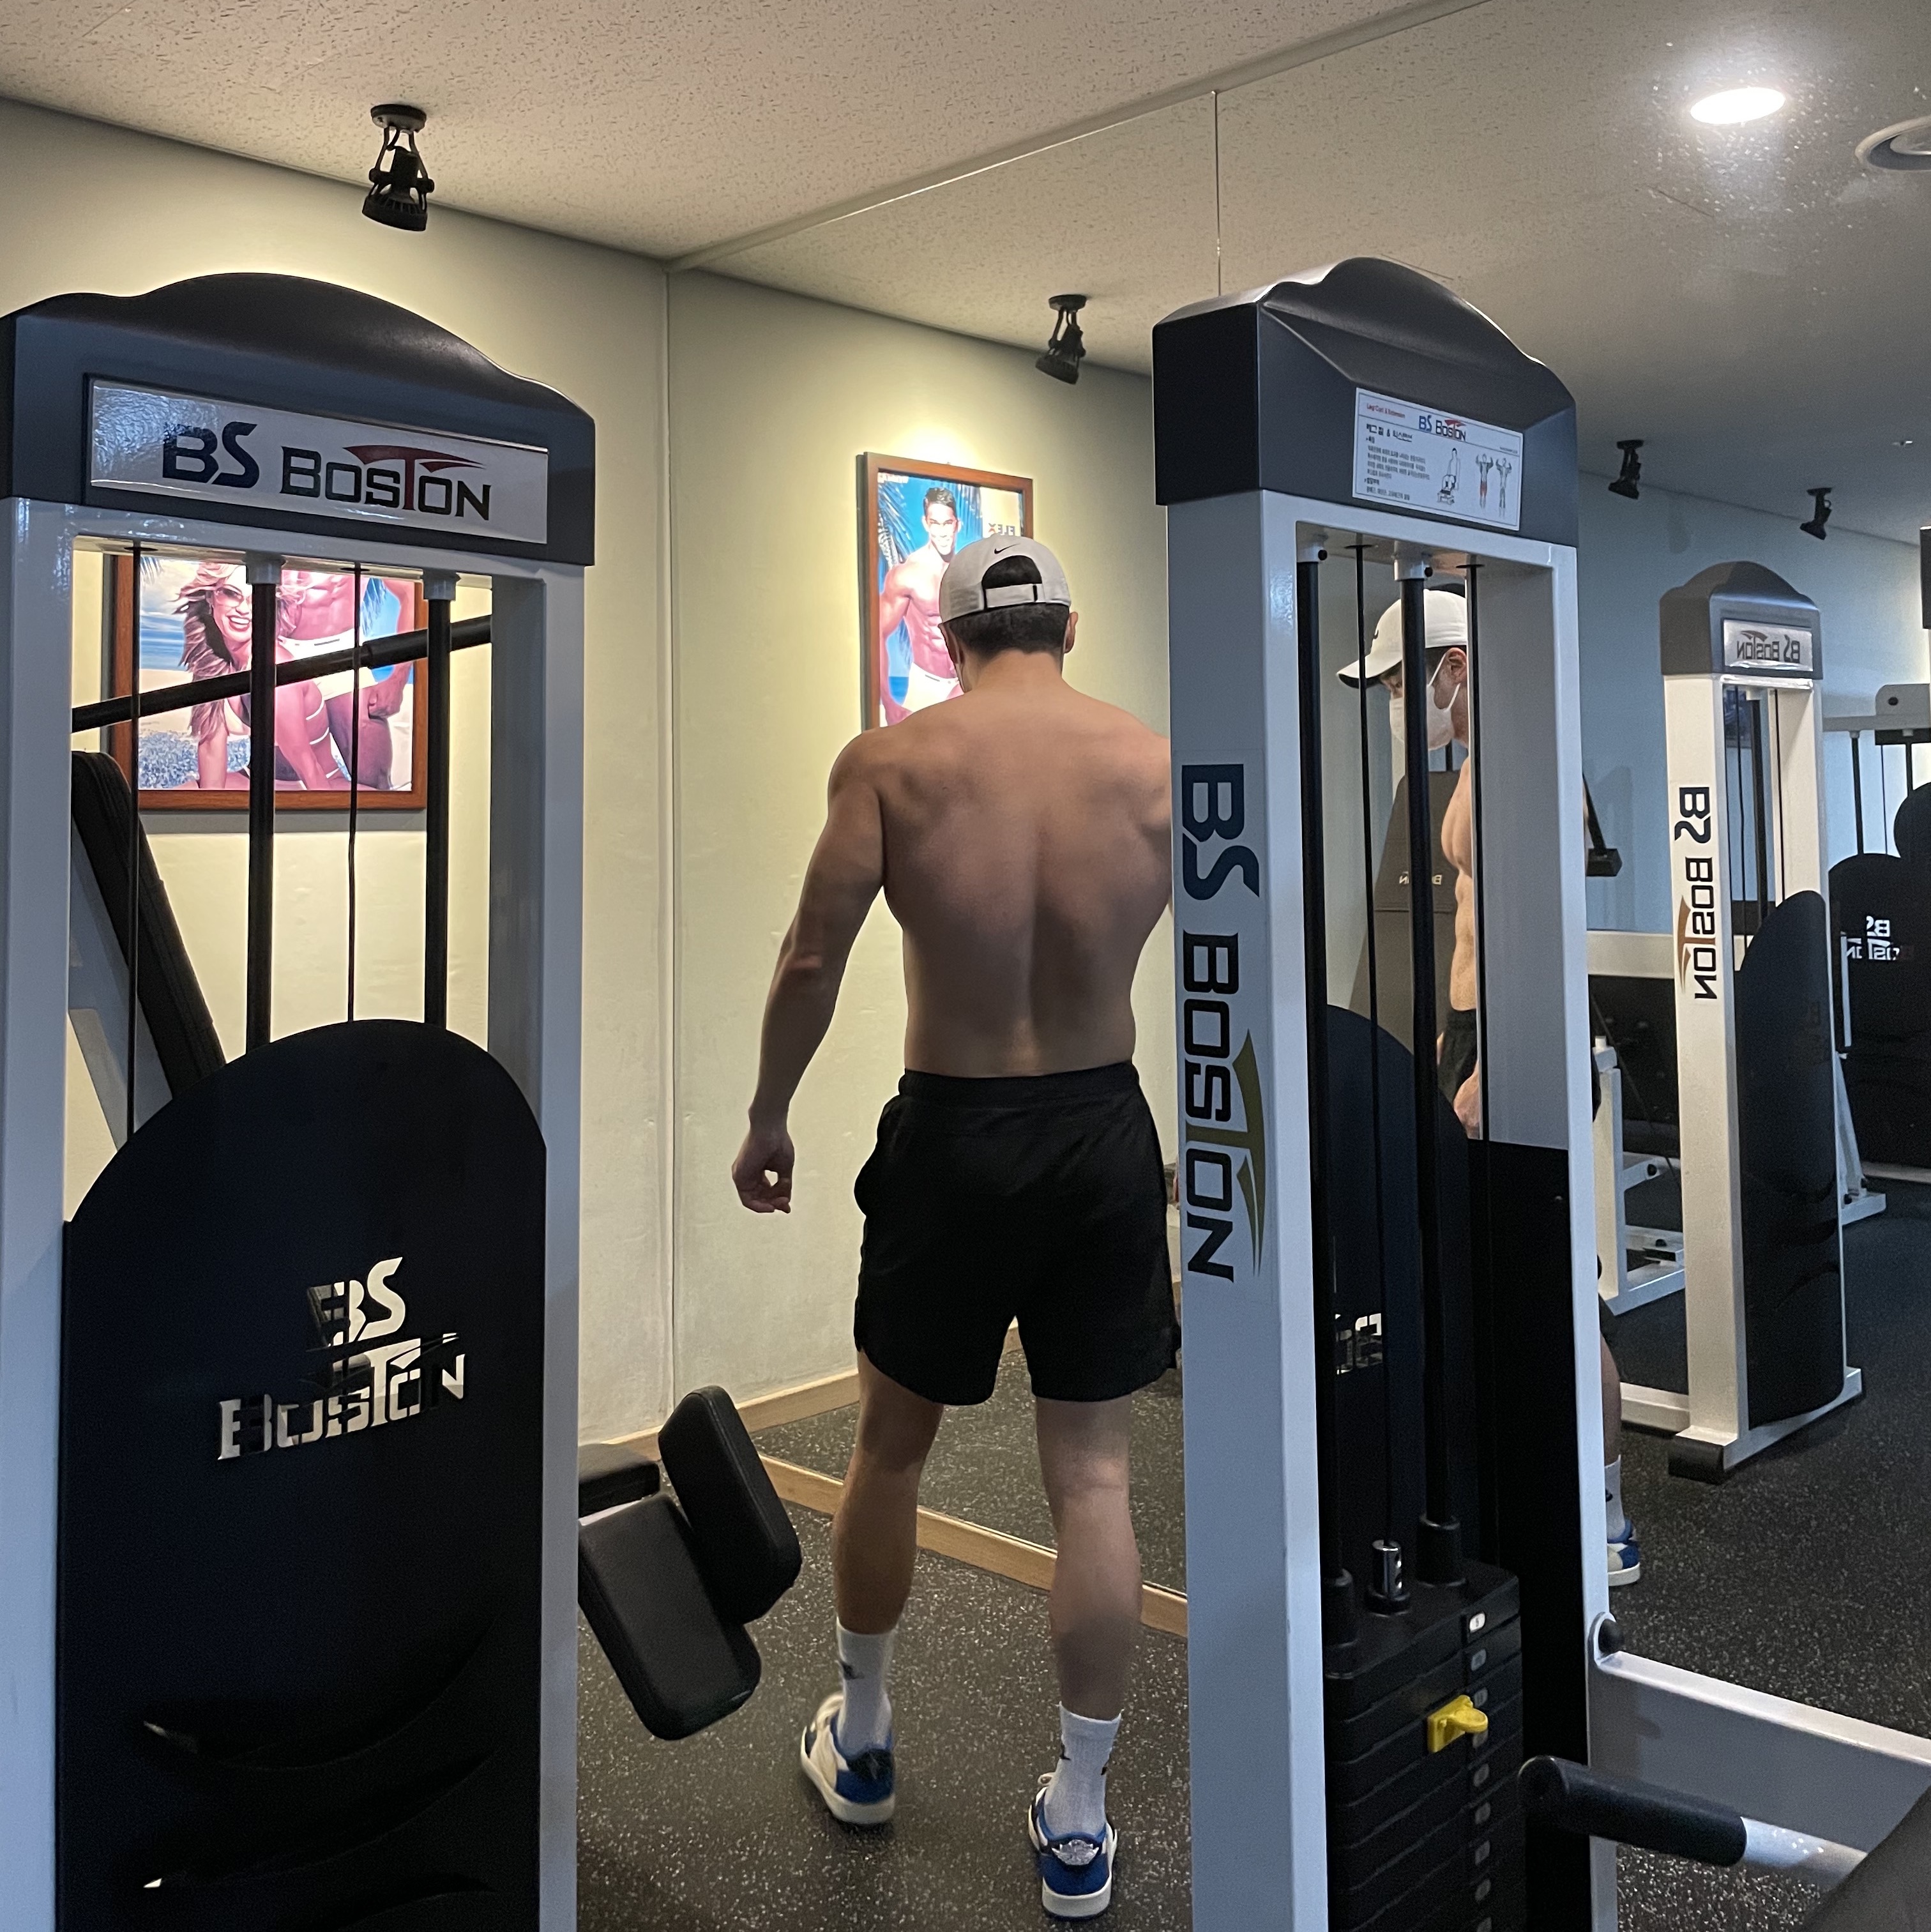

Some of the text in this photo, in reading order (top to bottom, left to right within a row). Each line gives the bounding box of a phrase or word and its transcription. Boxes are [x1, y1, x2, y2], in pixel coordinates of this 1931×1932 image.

[162, 421, 492, 521] BS BOSTON
[1419, 415, 1432, 432] BS
[1435, 419, 1467, 442] BOSTON
[1181, 763, 1266, 1284] BS BOSTON
[307, 1256, 406, 1347] BS
